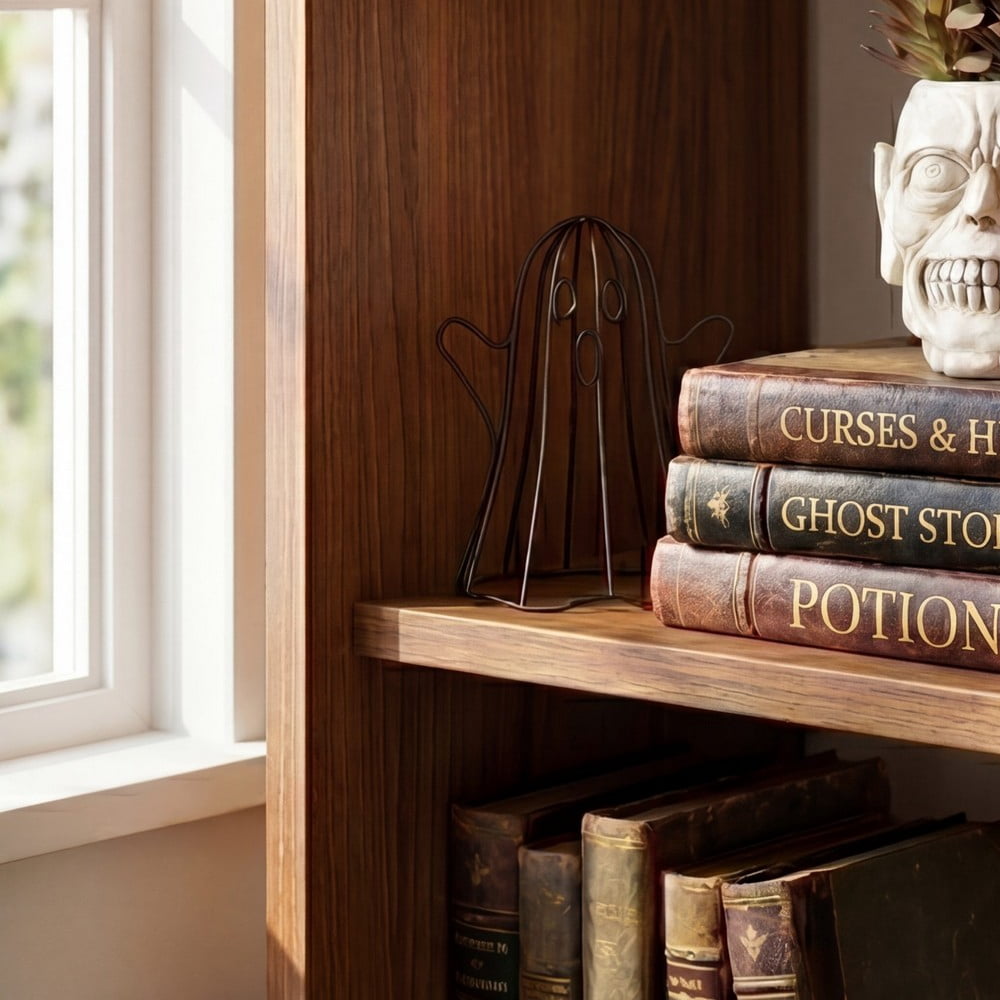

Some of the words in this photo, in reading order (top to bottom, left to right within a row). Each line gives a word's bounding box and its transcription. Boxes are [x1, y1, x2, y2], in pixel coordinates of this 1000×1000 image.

[779, 406, 918, 450] CURSES
[929, 419, 956, 452] &
[781, 496, 908, 541] GHOST
